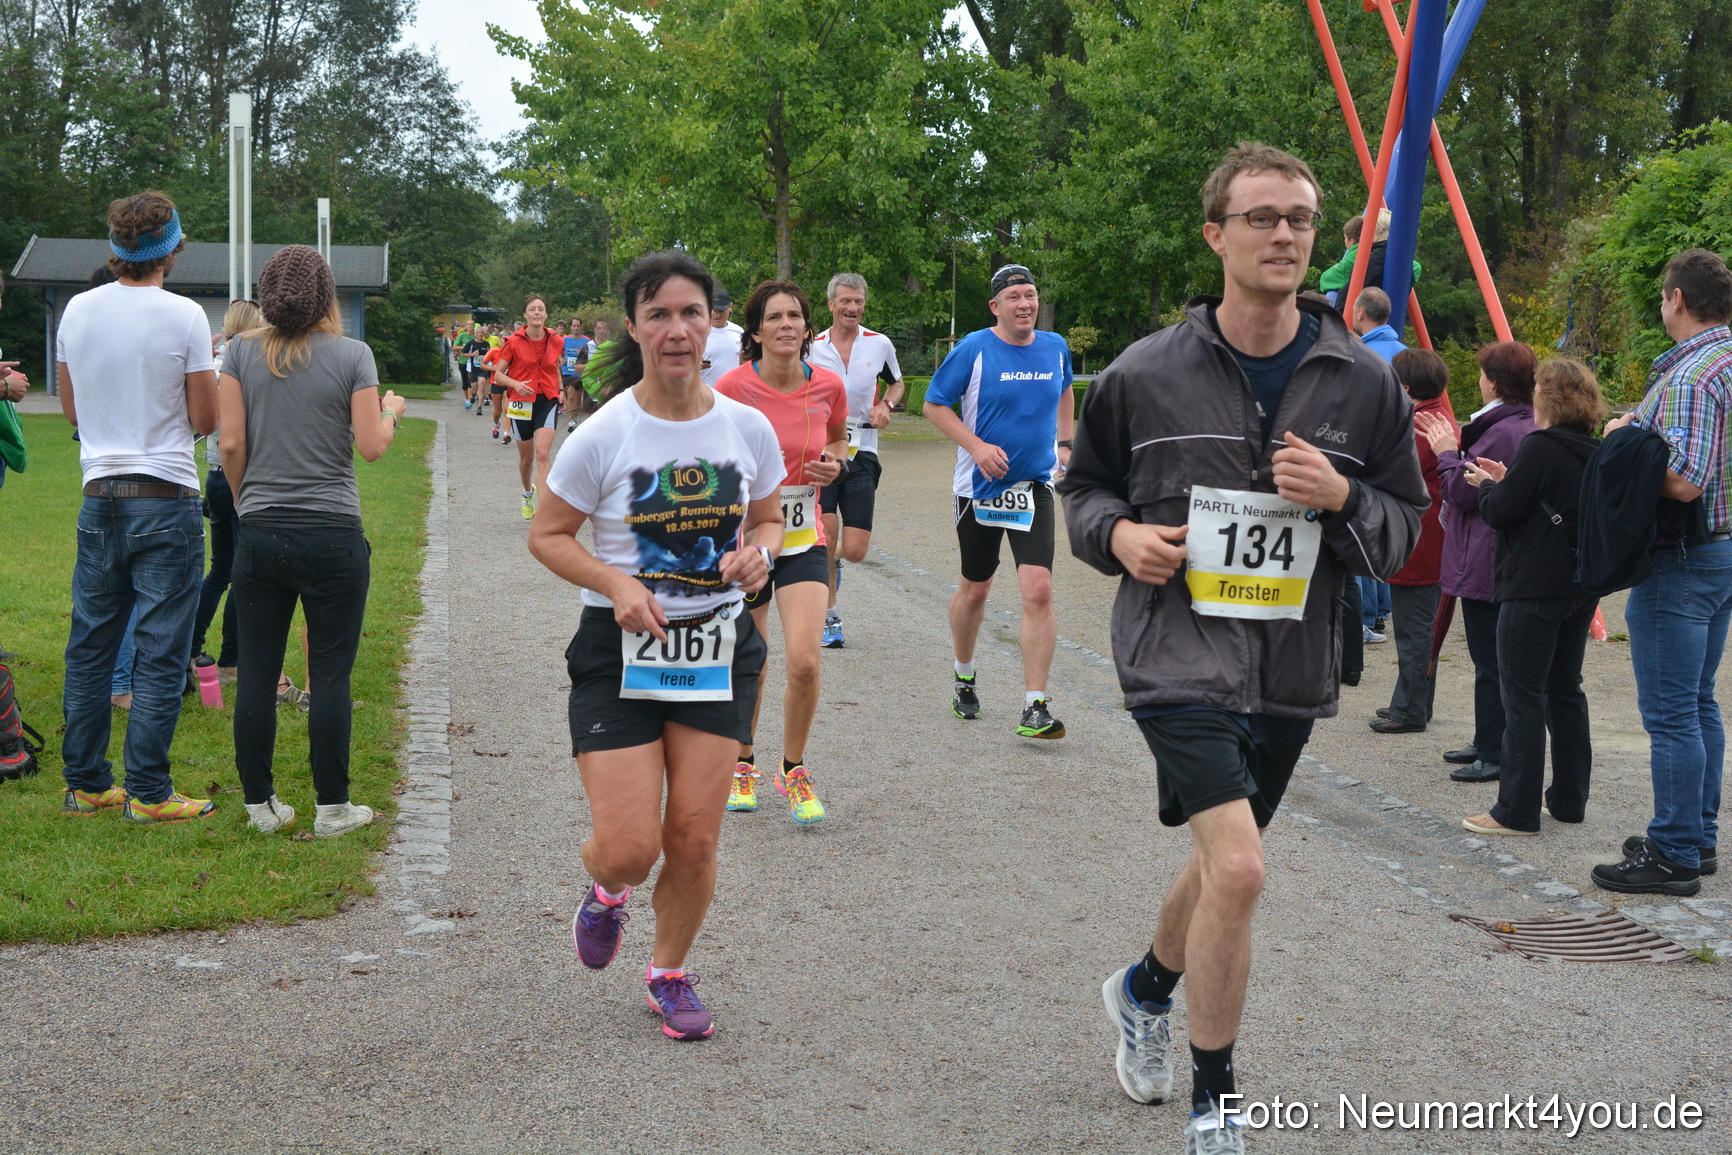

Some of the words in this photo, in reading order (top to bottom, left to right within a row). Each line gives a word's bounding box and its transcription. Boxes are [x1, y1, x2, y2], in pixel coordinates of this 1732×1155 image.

[1000, 371, 1033, 381] Ski-Club
[1034, 371, 1054, 381] Lauf
[780, 492, 806, 501] eumarkt
[624, 509, 677, 524] Amberger
[680, 504, 727, 517] Running
[729, 503, 747, 516] Nigh
[987, 512, 1020, 521] Andreas
[1193, 498, 1239, 515] PARTL
[1243, 505, 1301, 520] Neumarkt
[665, 519, 720, 533] 18.05.2013
[1218, 522, 1295, 571] 134
[1218, 580, 1281, 602] Torsten
[636, 625, 722, 663] 2061
[660, 672, 696, 687] Irene
